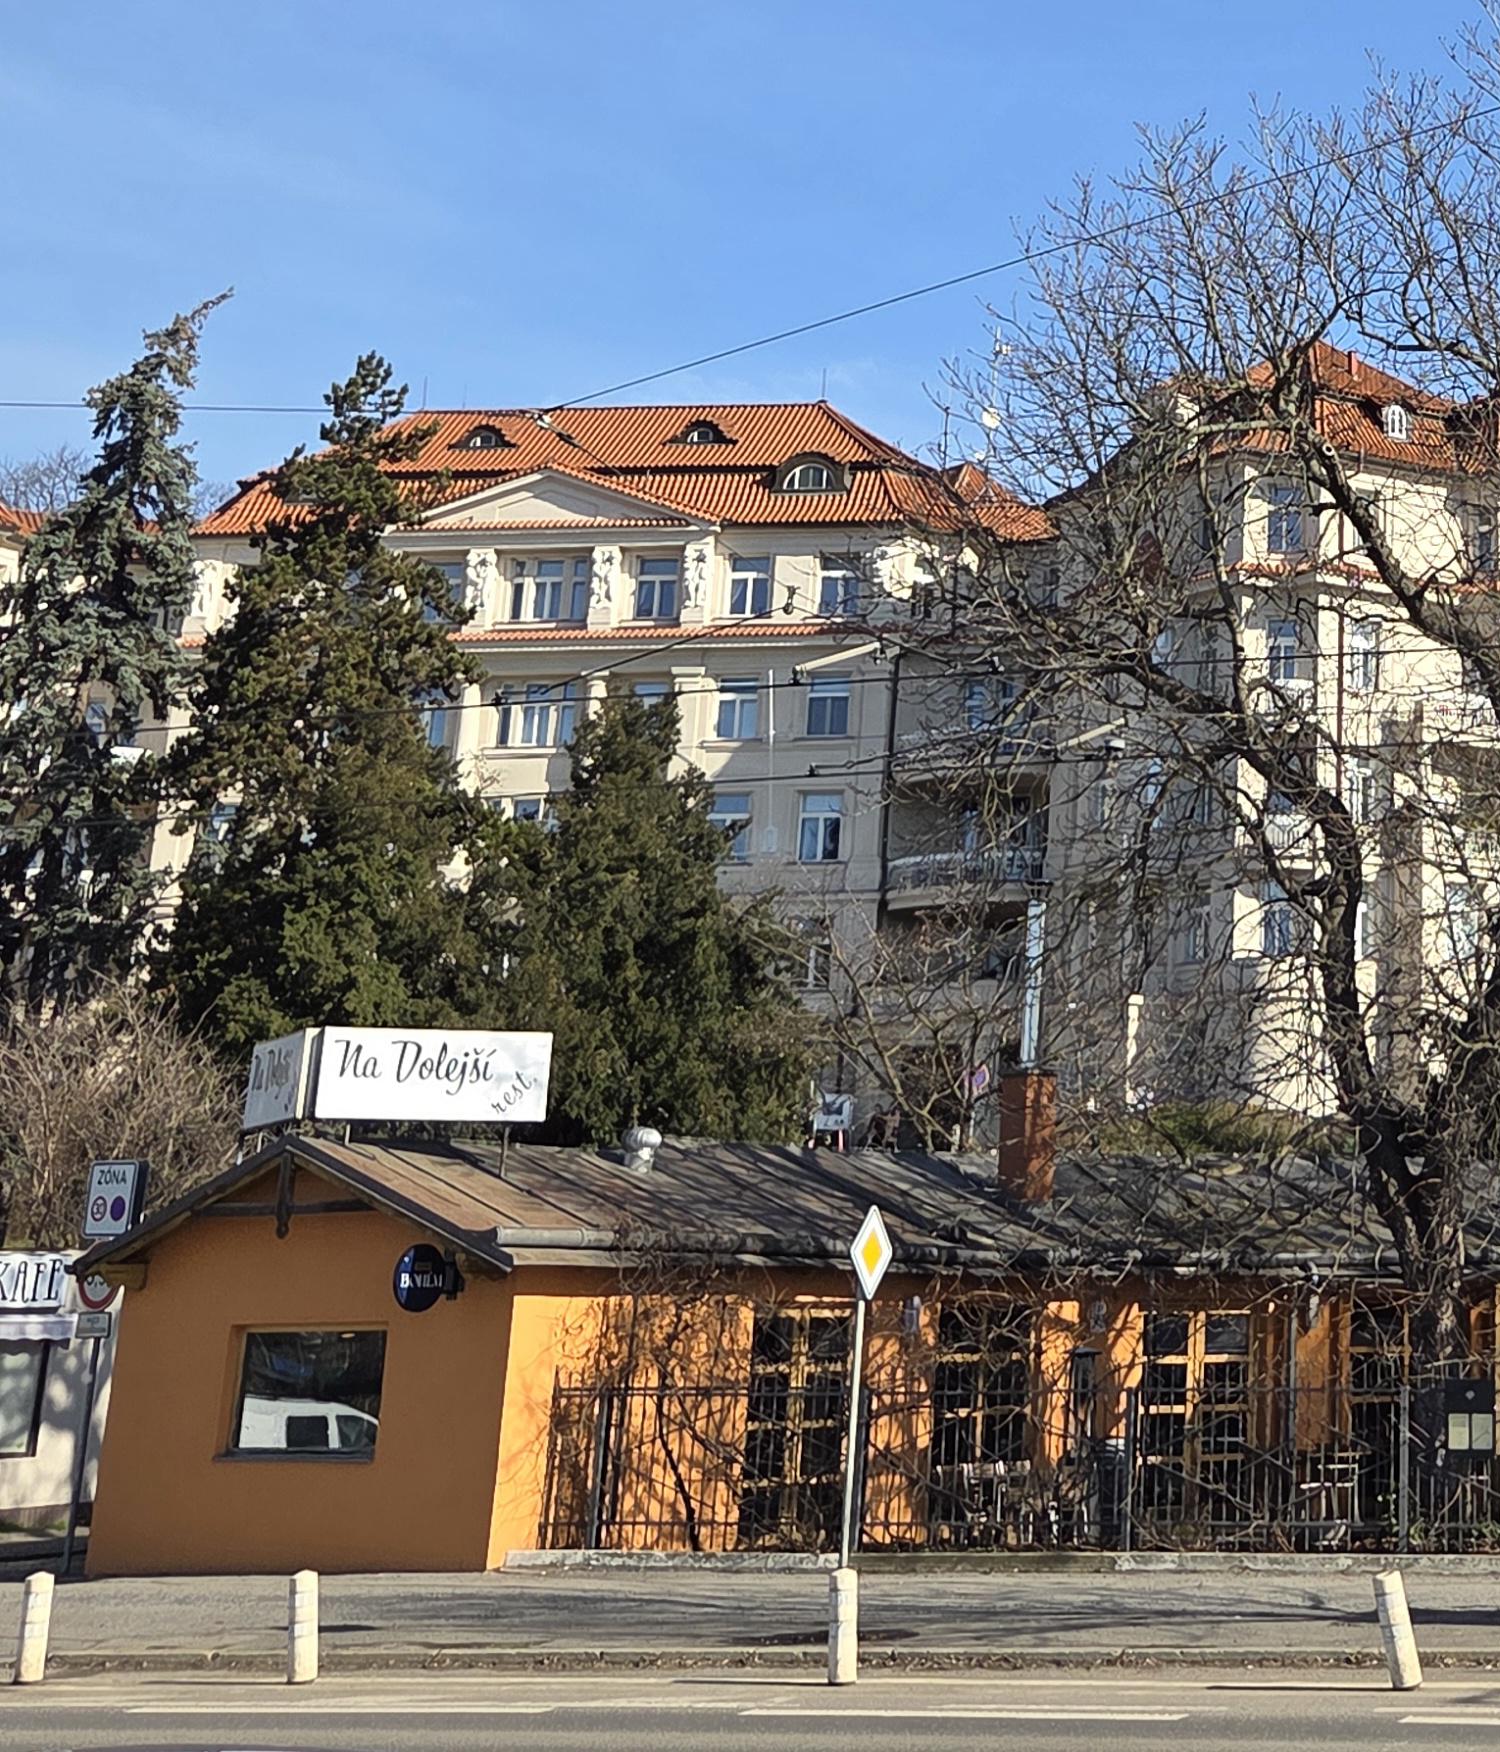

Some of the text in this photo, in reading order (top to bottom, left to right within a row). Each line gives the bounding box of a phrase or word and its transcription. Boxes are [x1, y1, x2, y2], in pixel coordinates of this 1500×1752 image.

[335, 1040, 382, 1078] Na
[391, 1040, 497, 1095] Dolejší
[491, 1071, 538, 1114] rest.
[97, 1166, 127, 1185] ZÓNA
